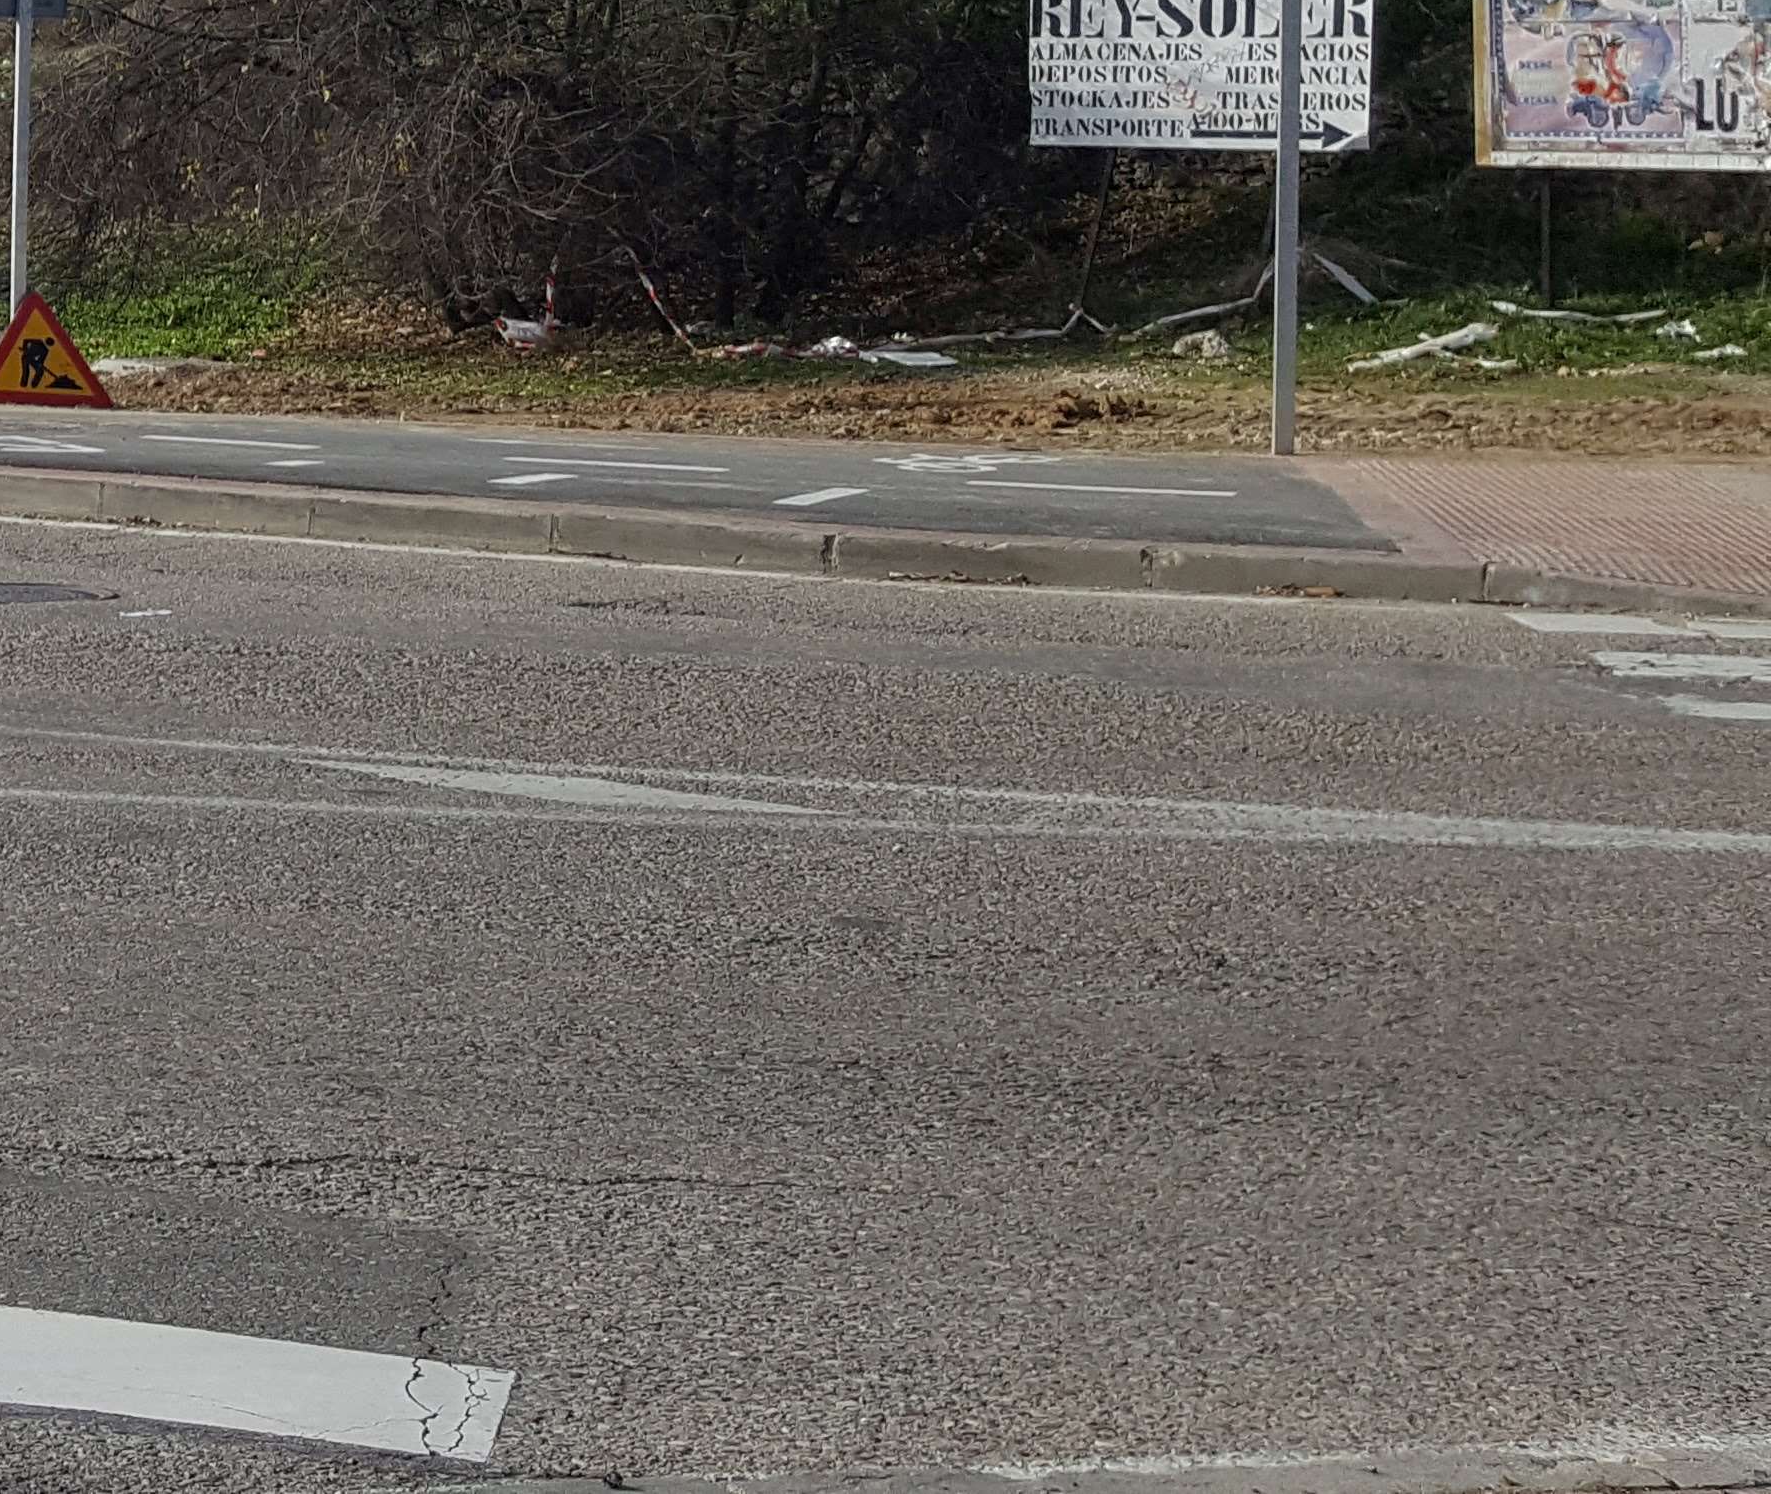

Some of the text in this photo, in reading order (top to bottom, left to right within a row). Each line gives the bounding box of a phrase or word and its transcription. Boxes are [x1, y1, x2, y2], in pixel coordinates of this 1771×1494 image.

[1031, 43, 1203, 62] ALMACENAJES
[1247, 42, 1369, 62] ESACIOS
[1031, 65, 1168, 84] DEPOSITOS
[1032, 90, 1171, 108] STOCKAJES
[1217, 91, 1367, 111] TRASEROS
[1031, 117, 1185, 139] TRANSPORTE
